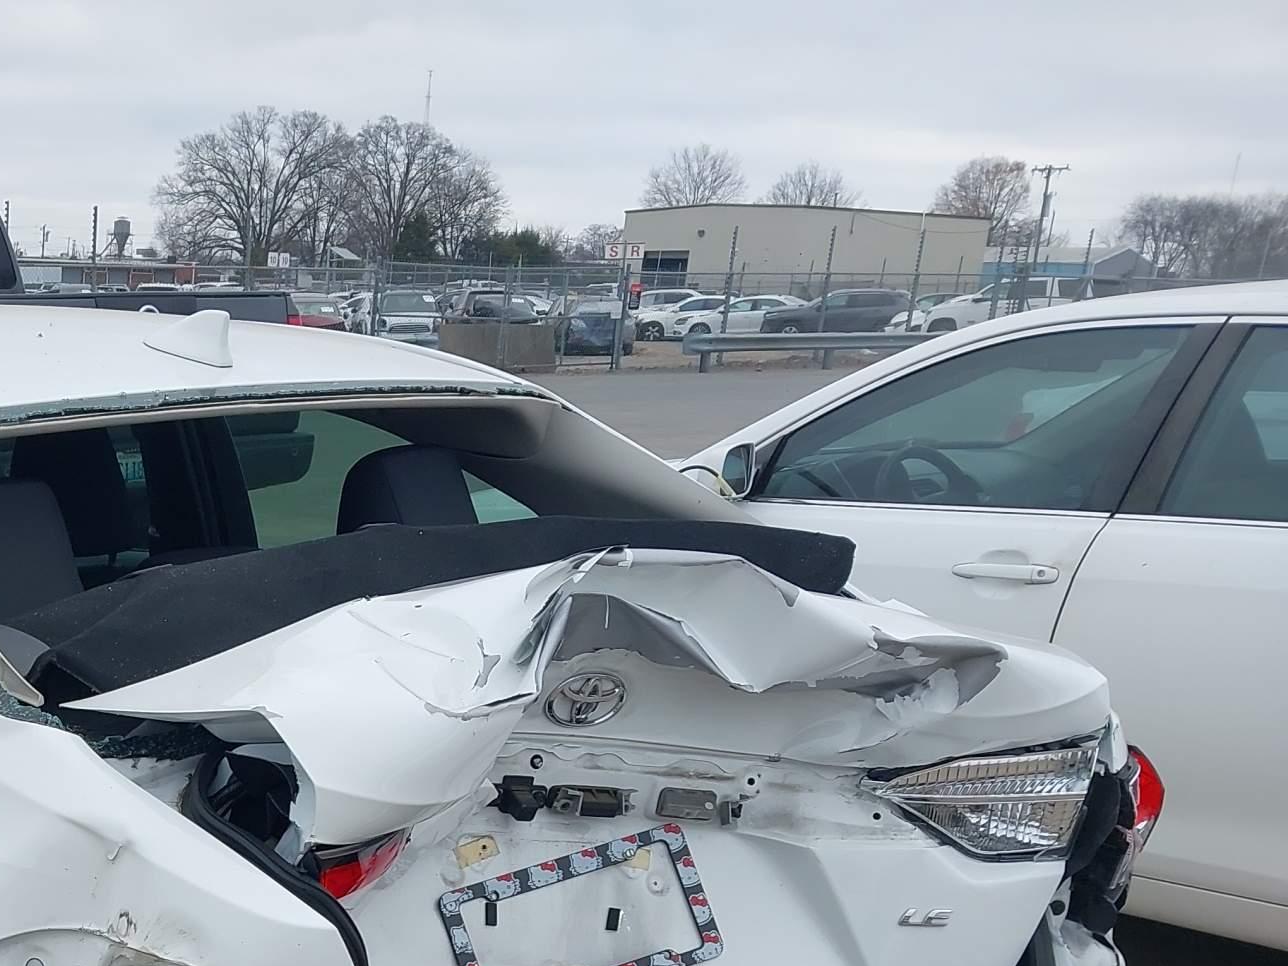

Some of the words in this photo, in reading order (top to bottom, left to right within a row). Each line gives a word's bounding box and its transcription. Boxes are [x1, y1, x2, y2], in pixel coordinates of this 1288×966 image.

[609, 245, 619, 257] S
[630, 245, 641, 257] R
[897, 908, 953, 927] LE
